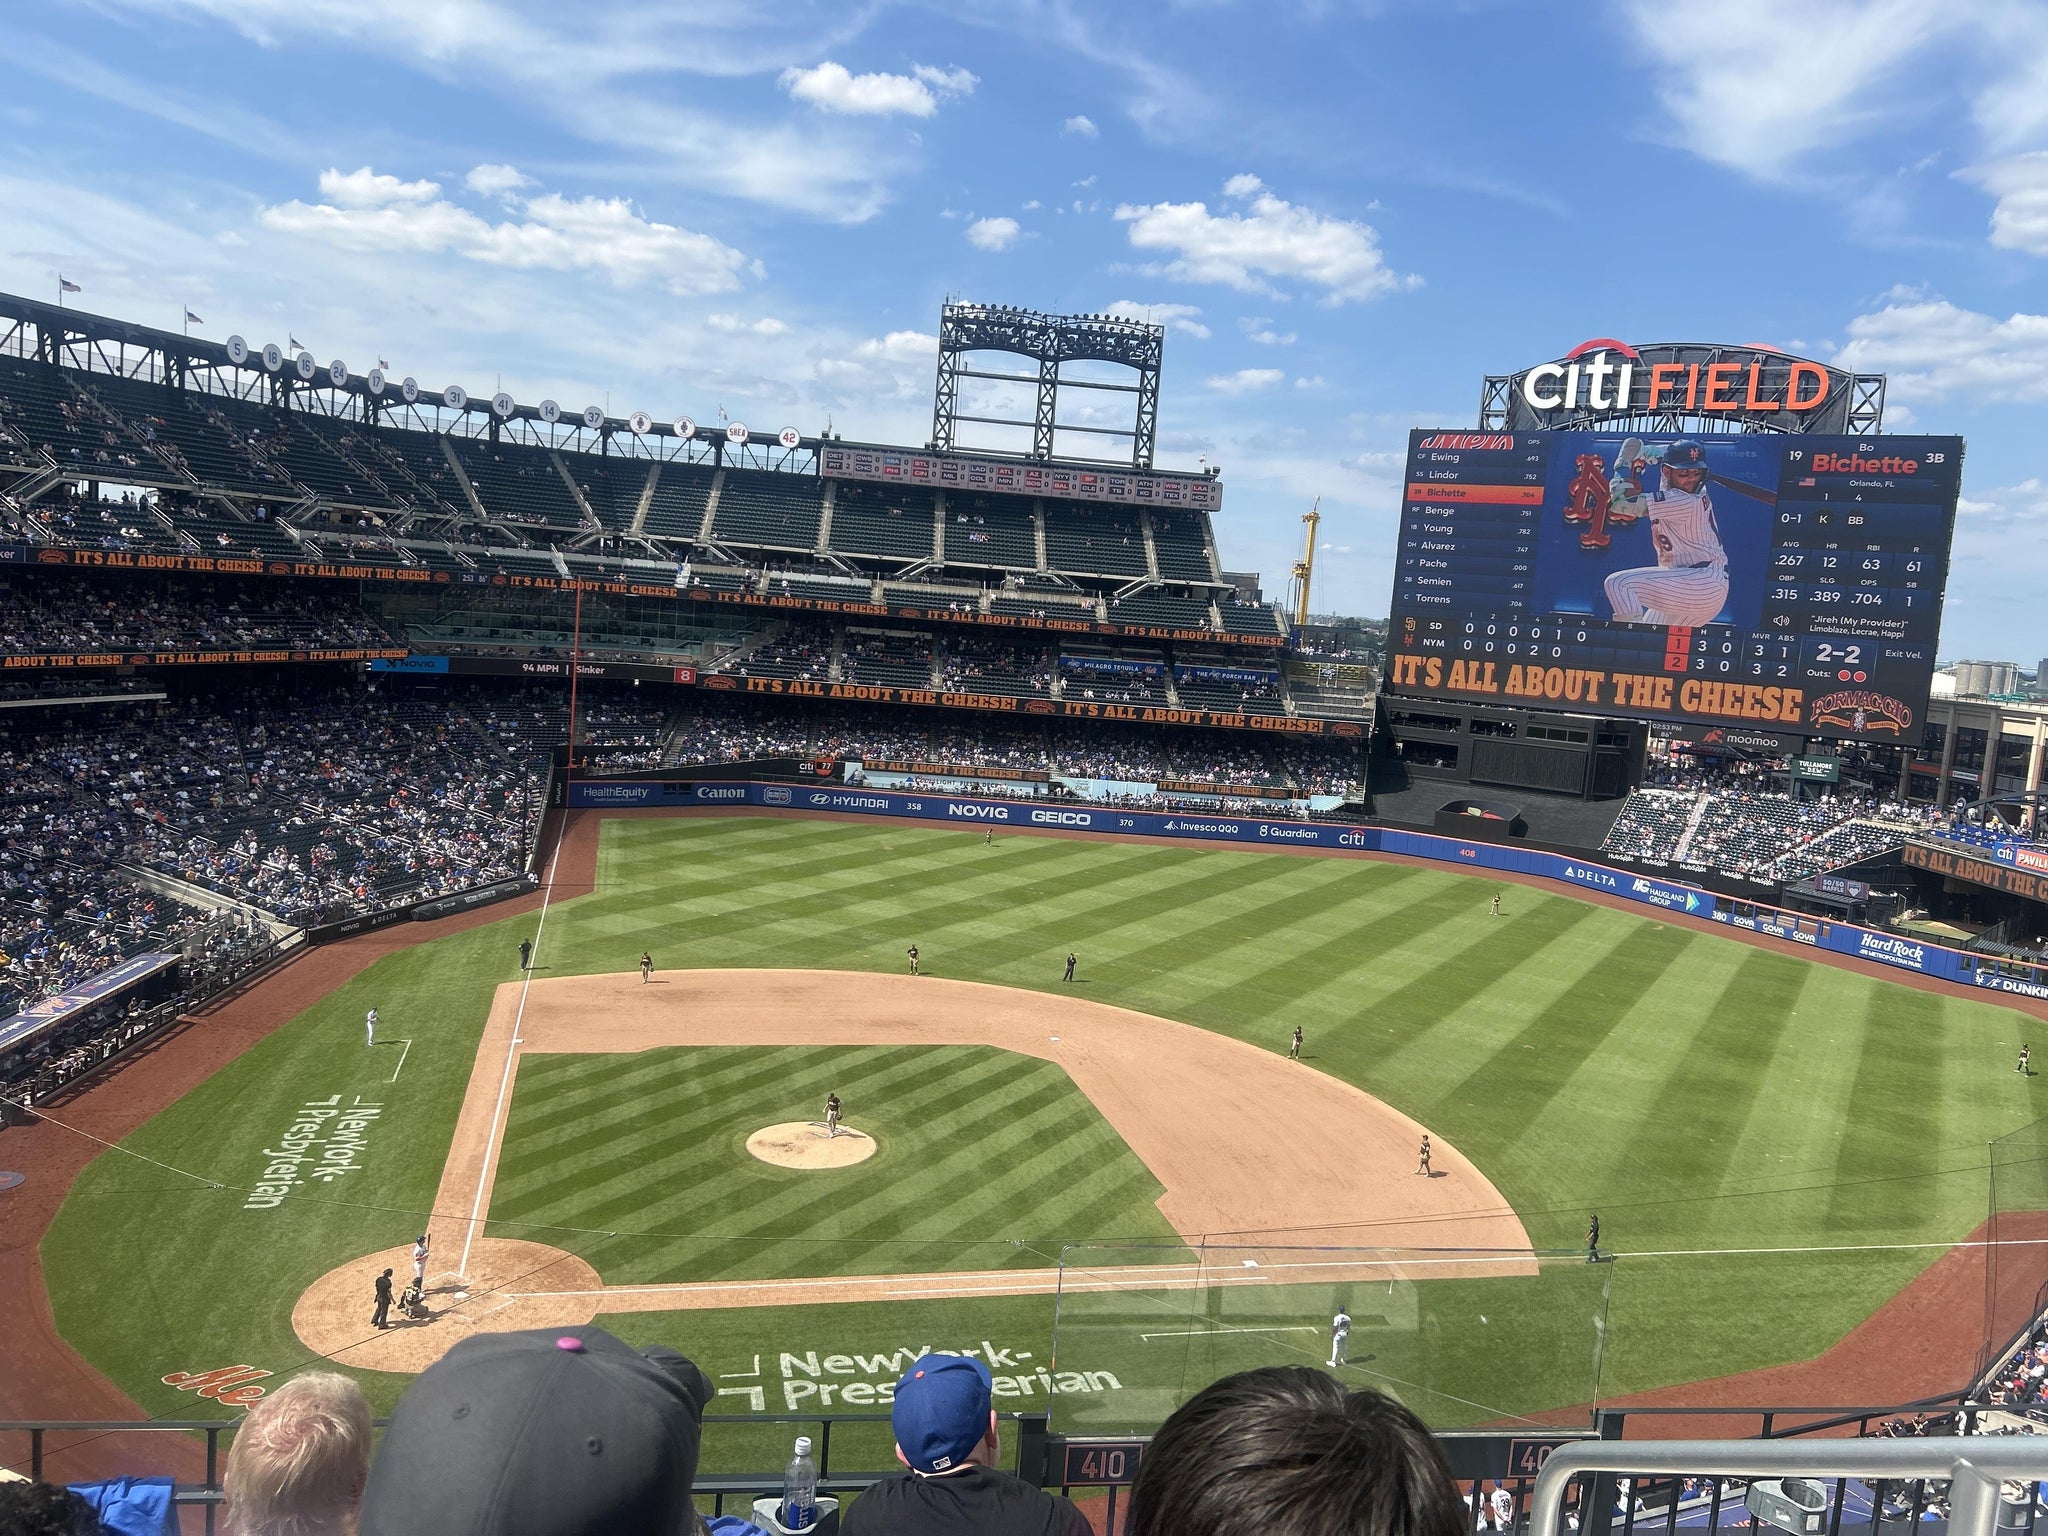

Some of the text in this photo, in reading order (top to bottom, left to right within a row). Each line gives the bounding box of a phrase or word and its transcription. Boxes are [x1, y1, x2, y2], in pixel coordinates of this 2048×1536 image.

[234, 344, 241, 355] 5
[268, 351, 277, 363] 18
[302, 360, 311, 371] 16
[334, 367, 344, 378] 24
[372, 376, 380, 387] 17
[1524, 351, 1830, 411] citi FIELD
[405, 384, 415, 395] 36
[450, 392, 461, 403] 31
[498, 400, 508, 410] 41
[545, 406, 555, 416] 14
[588, 412, 600, 422] 37
[729, 428, 746, 437] SHEA
[783, 433, 796, 442] 42
[1860, 443, 1874, 452] Bo
[1431, 453, 1459, 463] Ewing
[1790, 451, 1945, 474] 19 Bichette 3B
[1429, 471, 1458, 480] Lindor
[1849, 480, 1883, 489] Orlando,
[1427, 489, 1466, 498] Bichette
[1425, 506, 1455, 517] Benge
[1781, 513, 1864, 525] 0-1 BB
[1423, 524, 1453, 535] Young
[1421, 541, 1456, 551] Alvarez
[74, 551, 103, 564] IT'S
[107, 553, 133, 566] ALL
[139, 554, 185, 569] ABOUT
[188, 557, 214, 570] THE
[217, 558, 264, 573] CHEESE
[1419, 559, 1448, 568] Pache
[1775, 555, 1921, 572] .267 12 63 61
[1417, 577, 1452, 586] Semien
[1416, 594, 1451, 604] Torrens
[1771, 589, 1882, 606] .315 .389 .704
[718, 592, 888, 615] IT'S ALL ABOUT THE CHEESE
[1430, 622, 1443, 630] SD
[1841, 617, 1909, 629] (My Provider)"
[1124, 625, 1284, 646] IT'S ALL ABOUT THE CHEESE
[1778, 634, 1795, 642] ABS
[1809, 625, 1905, 640] Limoblaze, Lecrae, Happi
[1423, 638, 1445, 647] NYM
[1816, 644, 1861, 664] 2-2
[1885, 650, 1922, 659] Exit Vel.
[5, 653, 123, 667] ABOUT THE CHEESE!
[522, 664, 605, 674] 94 MPH Sinker
[1084, 663, 1112, 672] MILAGRO
[1113, 665, 1139, 673] TEQUILA
[1807, 669, 1831, 678] Outs:
[681, 671, 690, 681] 8
[1222, 672, 1243, 680] PORCH
[747, 678, 783, 693] IT'S
[788, 680, 824, 696] ALL
[830, 683, 894, 702] ABOUT
[900, 689, 937, 704] THE
[942, 692, 1018, 711] CHEESE!
[1392, 654, 1803, 724] IT'S ALL ABOUT THE CHEESE
[1810, 690, 1912, 728] FORMAGGIO
[1064, 703, 1099, 717] IT'S
[1104, 705, 1137, 719] ALL
[1142, 708, 1203, 725] ABOUT
[1209, 713, 1245, 728] THE
[1250, 716, 1324, 733] CHEESE!
[1727, 734, 1778, 748] moomoo
[1798, 760, 1833, 769] TULLAMORE
[584, 787, 649, 798] HealthEquity
[698, 786, 745, 798] Canon
[833, 796, 889, 809] HYUNDAI
[907, 803, 922, 811] 358
[949, 804, 1009, 819] NOVIG
[1031, 810, 1091, 825] GEICO
[1120, 819, 1133, 827] 370
[1180, 821, 1239, 834] Invesco QQQ
[1271, 828, 1318, 839] Guardian
[1339, 832, 1365, 846] citi
[1460, 849, 1475, 858] 408
[1608, 853, 1634, 863] HubSpot
[1997, 846, 2014, 860] citi
[1679, 862, 1706, 873] HubSpot
[1903, 844, 1927, 866] IT'S
[1929, 850, 1953, 874] ALL
[1955, 858, 2003, 886] ABOUT
[2006, 870, 2037, 896] THE
[1578, 869, 1617, 887] DELTA
[1720, 869, 1744, 880] HubSpot
[1649, 889, 1685, 903] HAUGLAND
[1649, 896, 1671, 906] GROUP
[377, 912, 397, 923] DELTA
[1712, 910, 1727, 922] 380
[1734, 916, 1755, 927] GOYA
[341, 922, 360, 932] NOVIG
[1763, 923, 1784, 935] GOYA
[1793, 930, 1815, 943] GOYA
[1861, 934, 1923, 962] Hard Rock
[1869, 951, 1907, 966] METROPOLITAN
[243, 1110, 339, 1209] Presbyterian
[161, 1364, 274, 1410] Me
[783, 1366, 1122, 1411] Preserian
[1081, 1450, 1126, 1478] 410
[1521, 1445, 1553, 1472] 40
